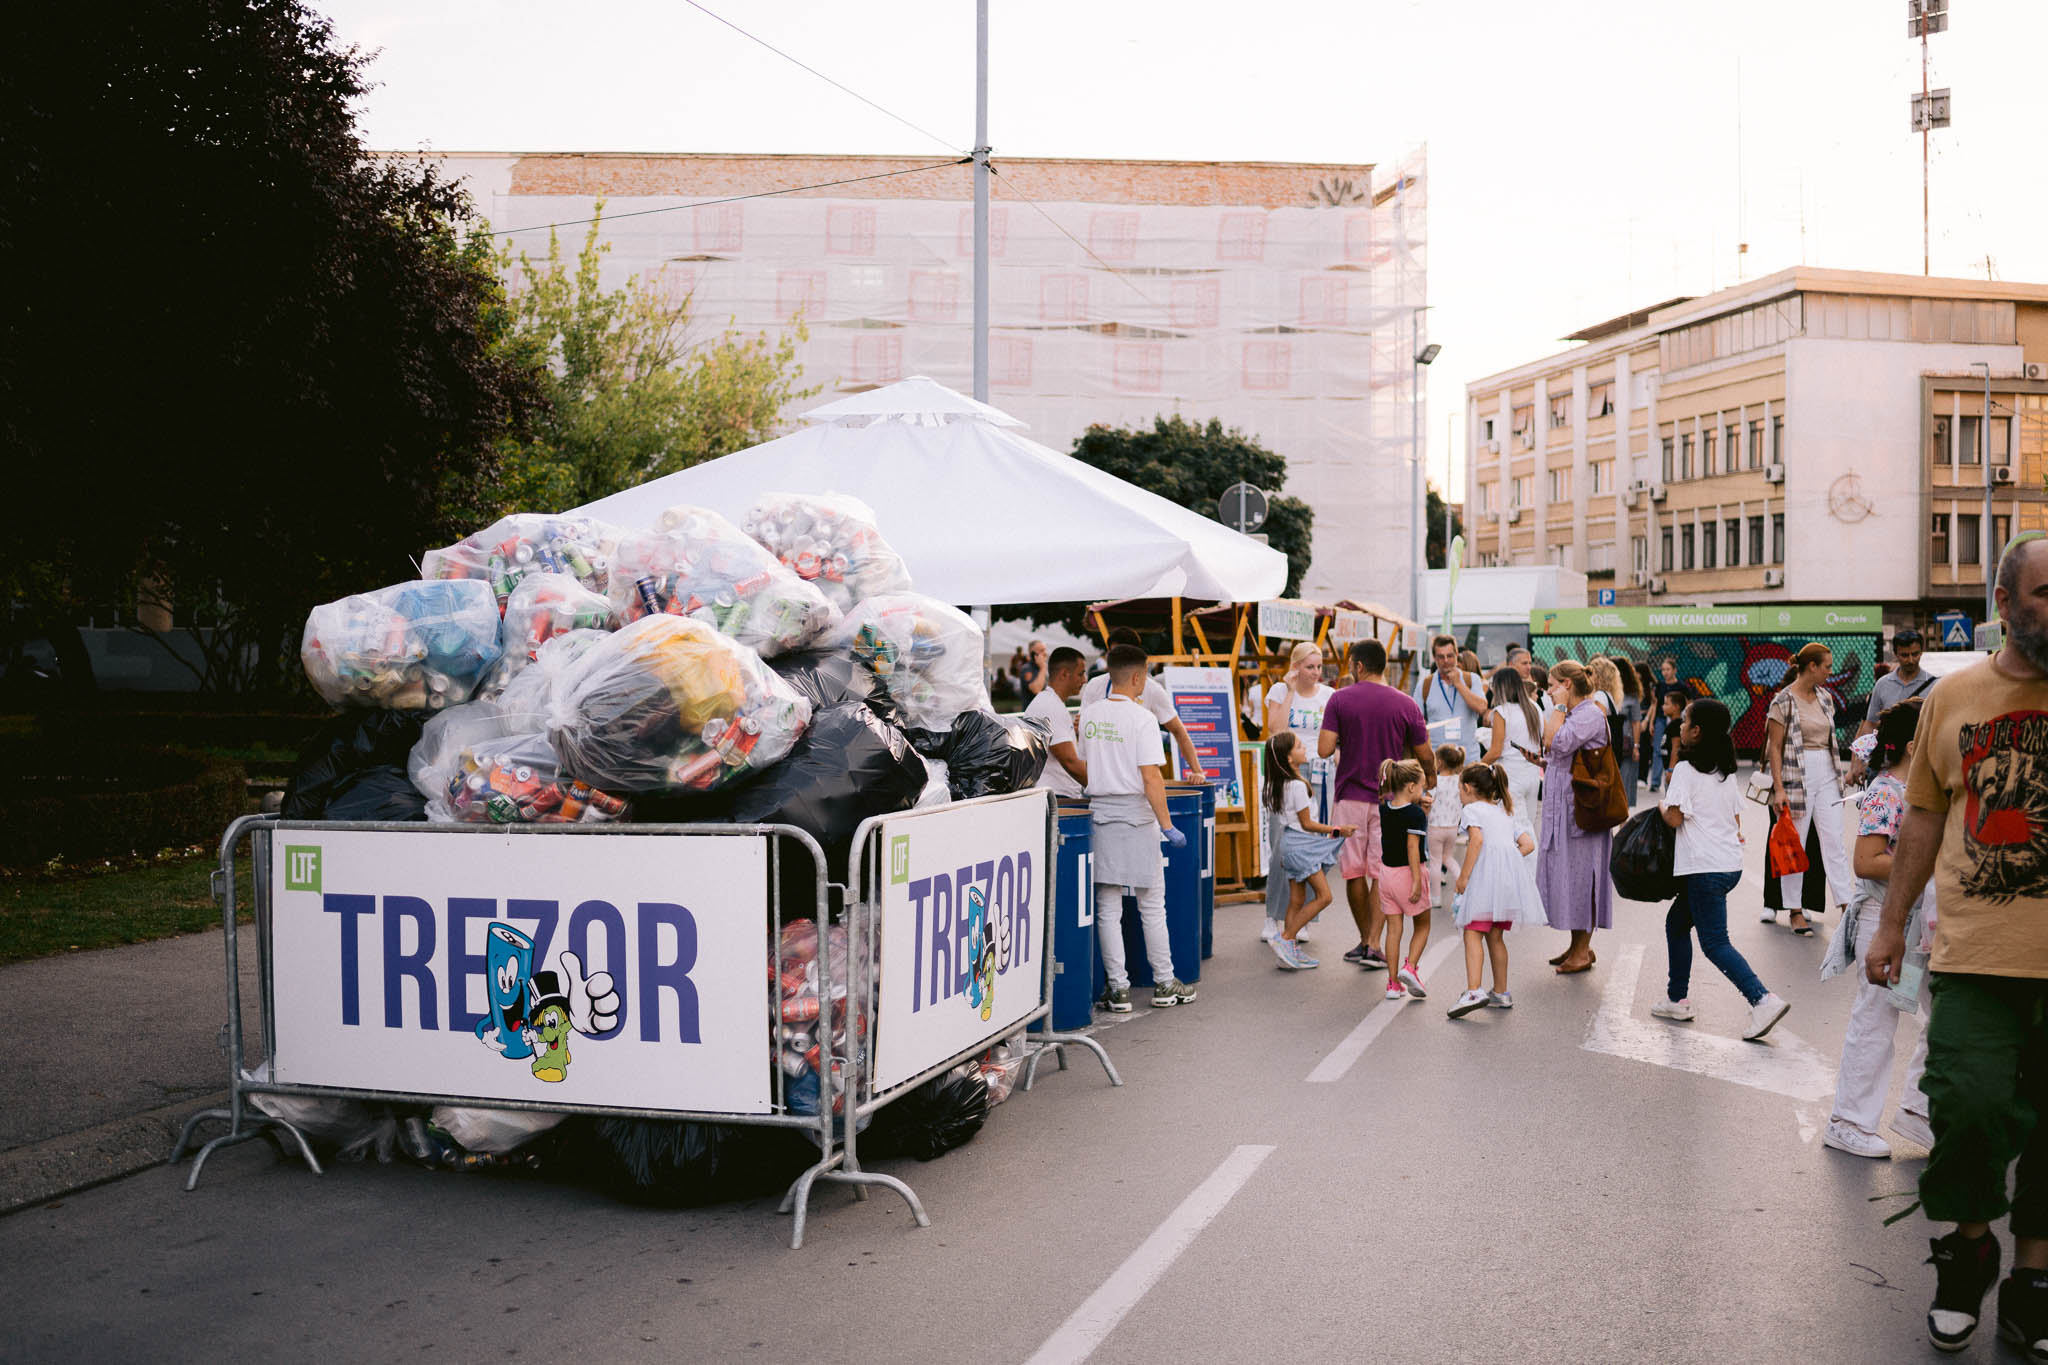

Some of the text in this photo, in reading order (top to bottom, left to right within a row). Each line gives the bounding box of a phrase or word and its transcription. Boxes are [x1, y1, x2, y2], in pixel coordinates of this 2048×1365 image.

[1602, 590, 1612, 604] P
[1648, 614, 1748, 625] EVERY CAN COUNTS
[1992, 718, 2015, 748] THE
[291, 852, 317, 884] LTF
[894, 842, 907, 877] LTF
